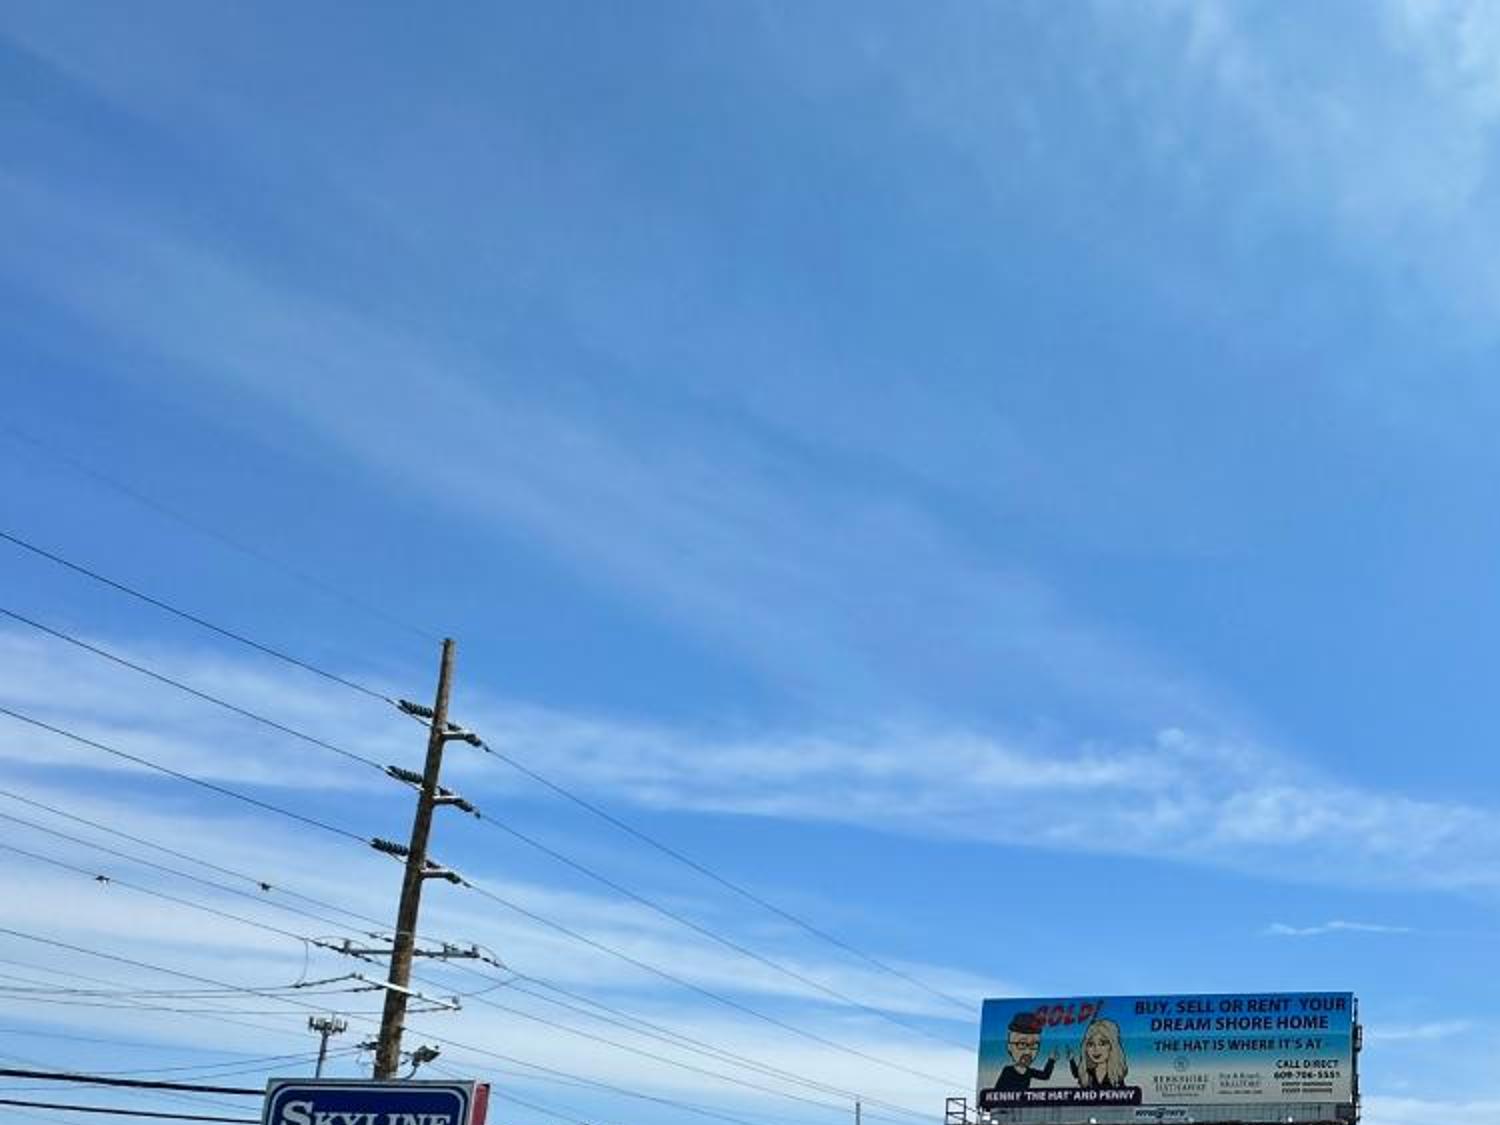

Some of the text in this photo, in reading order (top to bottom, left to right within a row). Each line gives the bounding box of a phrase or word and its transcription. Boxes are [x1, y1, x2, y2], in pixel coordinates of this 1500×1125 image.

[1135, 997, 1345, 1015] BUY, SELL OR RENT YOUR
[1151, 1015, 1329, 1032] DREAM SHORE HOME
[1154, 1040, 1179, 1052] THE
[1183, 1039, 1209, 1051] HAT
[1213, 1039, 1225, 1051] IS
[1227, 1038, 1275, 1050] WHERE
[1305, 1037, 1323, 1049] AT
[1275, 1059, 1301, 1069] CALL
[985, 1091, 1022, 1101] KENNY
[1073, 1090, 1097, 1100] AND
[1099, 1090, 1135, 1100] PENNY
